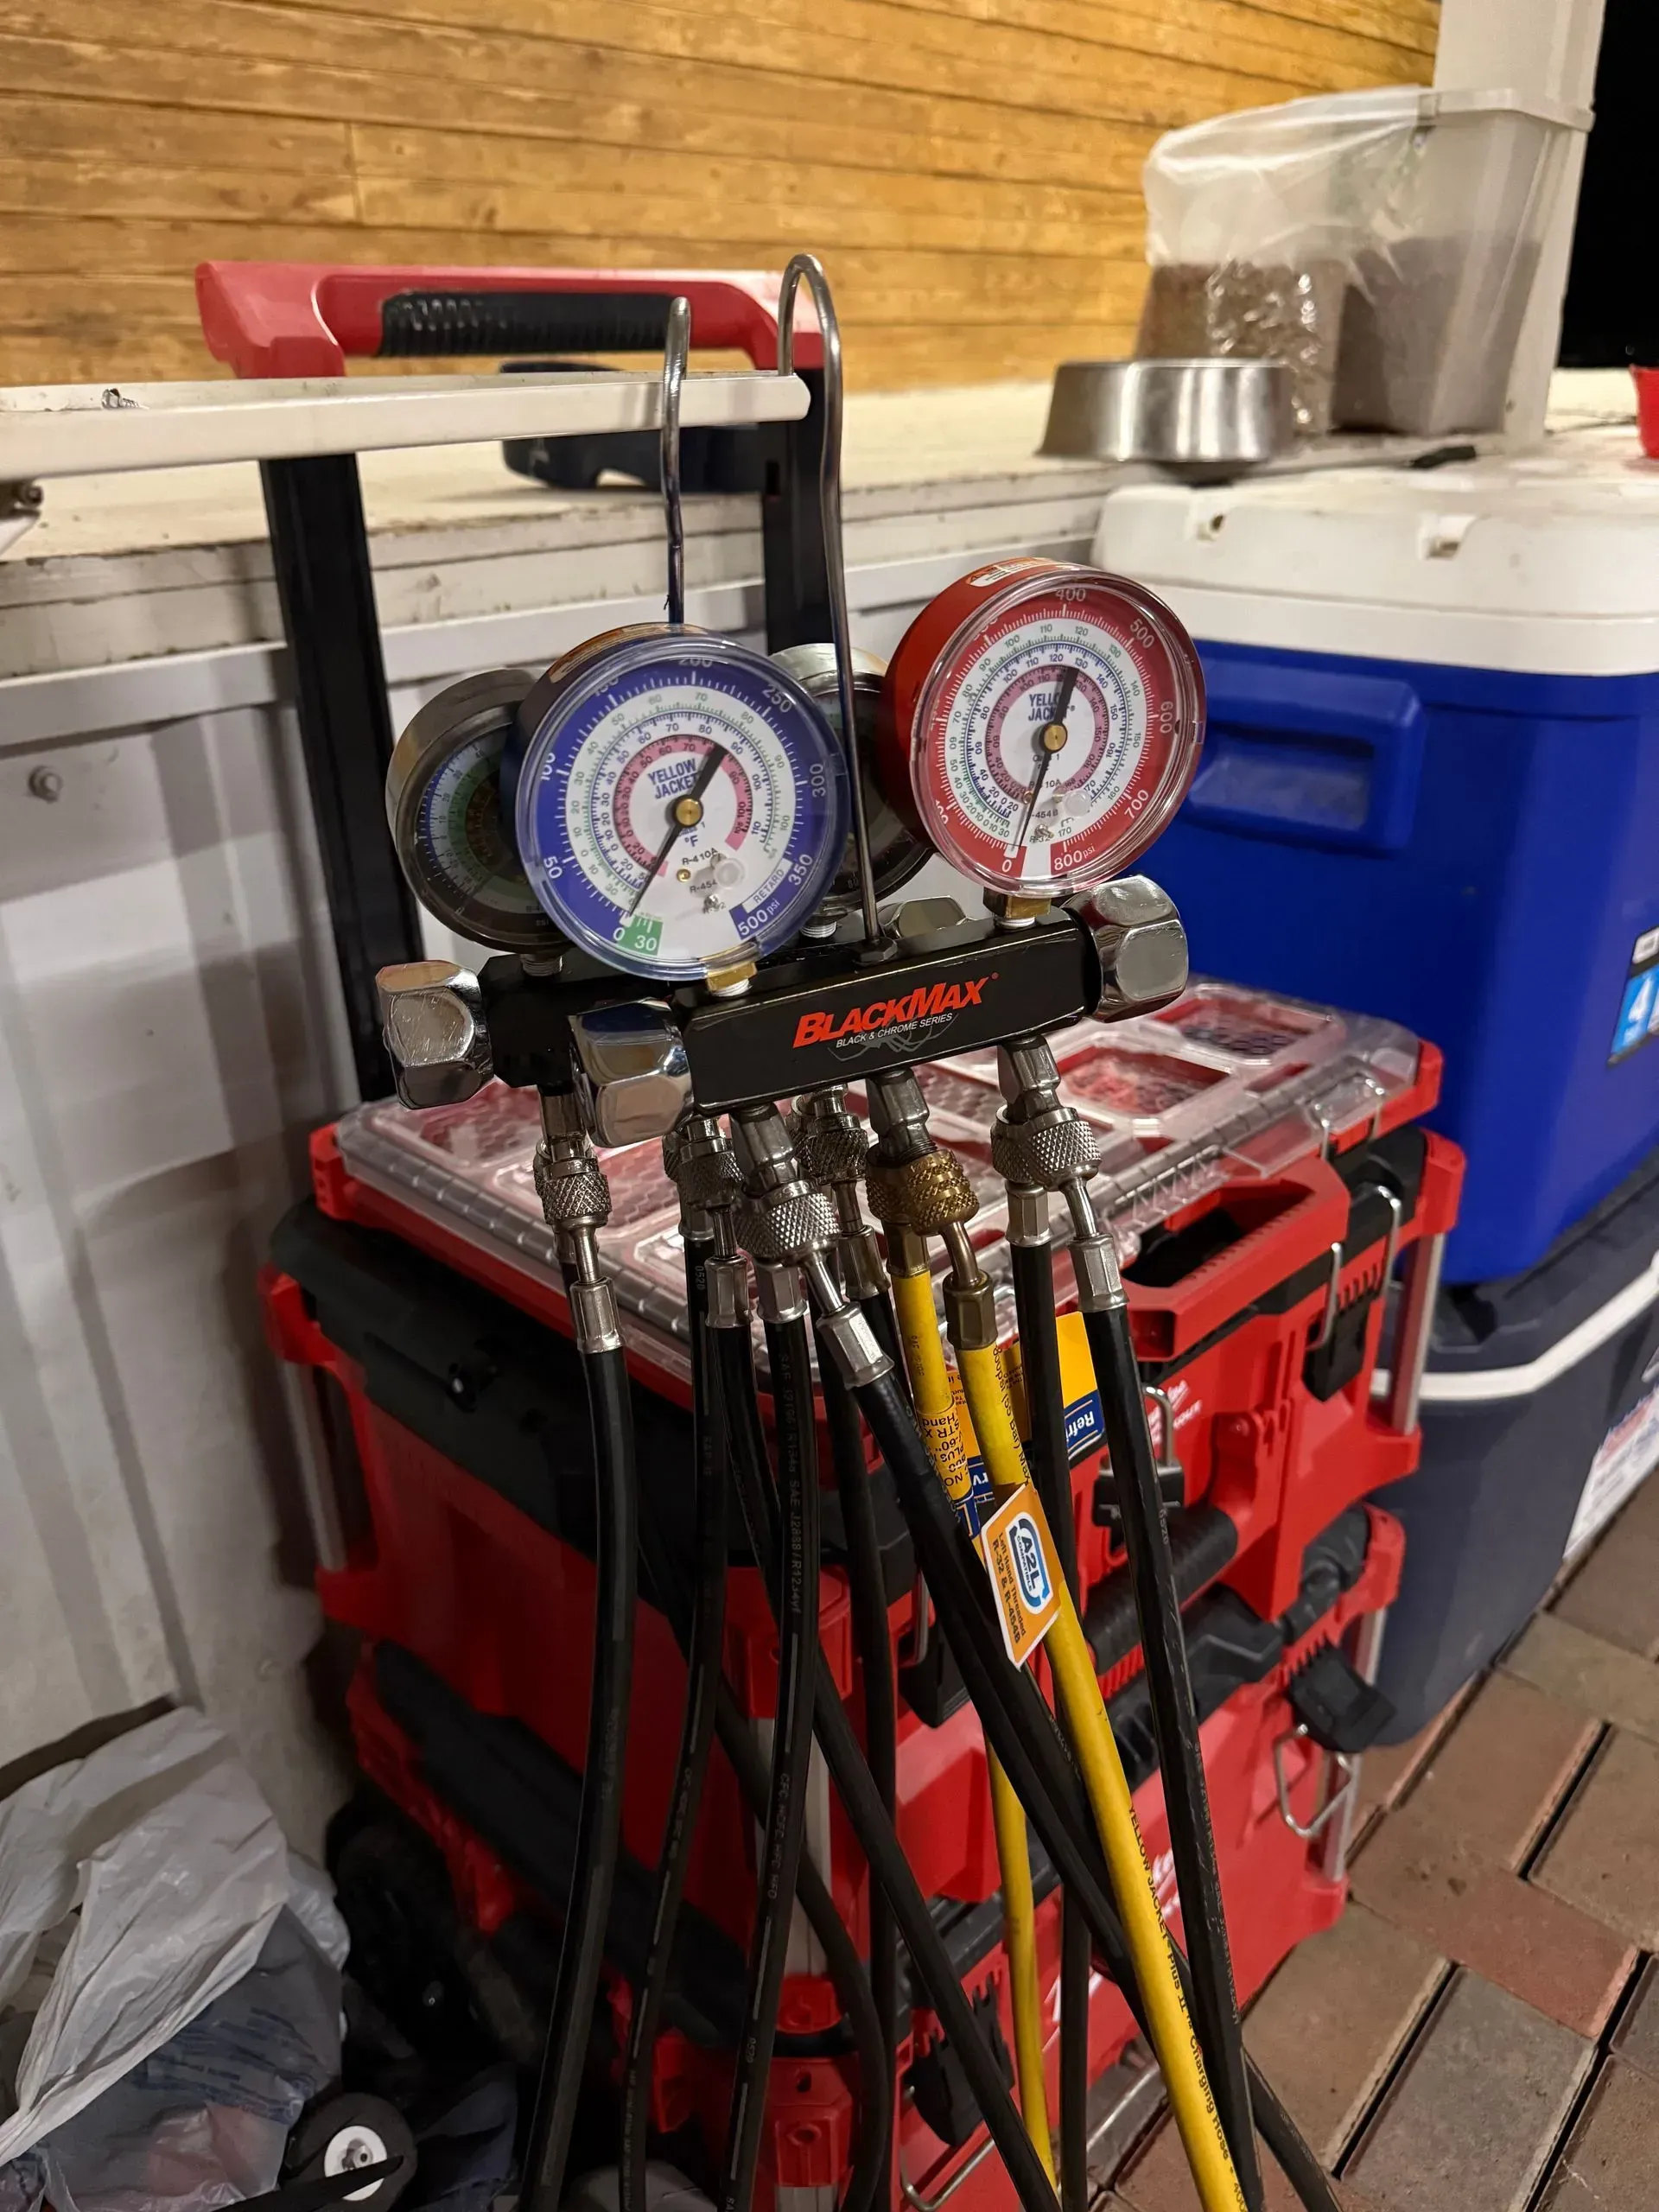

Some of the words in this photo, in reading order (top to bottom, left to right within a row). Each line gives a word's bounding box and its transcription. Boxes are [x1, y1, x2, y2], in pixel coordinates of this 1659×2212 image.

[1055, 588, 1086, 602] 400
[1040, 624, 1052, 633] 110
[1075, 626, 1088, 636] 120
[1129, 618, 1154, 649] 500
[1004, 634, 1020, 647] 100
[1110, 643, 1122, 658] 130
[979, 658, 991, 671] 90
[1026, 657, 1039, 668] 110
[1049, 653, 1064, 663] 120
[1074, 658, 1088, 669] 130
[1002, 669, 1018, 684] 100
[1096, 674, 1109, 689] 140
[1130, 680, 1141, 696] 140
[695, 692, 709, 702] 70
[762, 683, 793, 713] 250
[1029, 693, 1060, 707] YELLO
[1090, 697, 1100, 713] 140
[1109, 703, 1118, 721] 150
[952, 711, 962, 724] 70
[980, 706, 990, 720] 80
[1028, 707, 1056, 721] JACK
[1160, 701, 1173, 734] 600
[666, 722, 679, 733] 70
[699, 724, 712, 734] 80
[683, 742, 696, 752] 70
[950, 736, 957, 750] 60
[975, 741, 982, 755] 60
[993, 735, 1000, 748] 60
[950, 760, 958, 772] 50
[995, 757, 1004, 769] 40
[574, 771, 585, 786] 30
[607, 771, 617, 785] 40
[648, 758, 696, 785] YELLOW
[980, 768, 988, 781] 40
[752, 773, 762, 791] 100
[809, 764, 826, 798] 300
[954, 777, 963, 789] 40
[1030, 779, 1062, 789] R10A
[601, 792, 610, 806] 30
[959, 791, 969, 804] 30
[988, 786, 1000, 798] 20
[1108, 785, 1120, 800] 160
[571, 800, 581, 814] 20
[737, 801, 746, 818] 100
[965, 802, 977, 814] 20
[1007, 802, 1018, 811] 20
[1124, 790, 1149, 820] 700
[601, 811, 611, 826] 20
[975, 812, 984, 822] 10
[1032, 809, 1058, 818] -454B
[752, 821, 761, 836] 110
[779, 815, 791, 831] 100
[988, 823, 998, 832] 10
[573, 826, 582, 838] 10
[605, 829, 613, 841] 10
[998, 829, 1010, 838] 30
[1058, 827, 1071, 837] 170
[581, 849, 589, 857] 0
[632, 842, 645, 855] 20
[620, 858, 633, 870] 20
[1054, 849, 1083, 871] 800
[1082, 844, 1096, 859] psi
[543, 855, 563, 880] 50
[788, 855, 813, 886] 350
[1002, 859, 1012, 872] 0
[606, 883, 619, 896] 30
[753, 869, 785, 904] RETARD
[738, 910, 768, 937] 500
[767, 899, 781, 916] psi
[613, 927, 626, 941] 0
[634, 935, 658, 951] 30
[836, 1033, 867, 1048] BLACK
[868, 1032, 874, 1040] &
[877, 1021, 918, 1038] CHROME
[919, 1013, 952, 1028] SERIES
[923, 1413, 956, 1427] Hand
[789, 1478, 800, 1507] SAE
[1016, 1535, 1033, 1592] COMPATIBLE
[1021, 1535, 1041, 1590] A2L
[993, 1538, 1004, 1574] R-32
[1001, 1576, 1007, 1588] &
[1004, 1589, 1021, 1643] R-454B
[998, 1532, 1007, 1554] Left
[1003, 1554, 1014, 1585] Hand
[1011, 1585, 1027, 1637] Threaded
[1128, 1805, 1150, 1872] YELLOW
[1168, 1954, 1180, 1990] Plus
[1190, 2036, 1215, 2113] Charging
